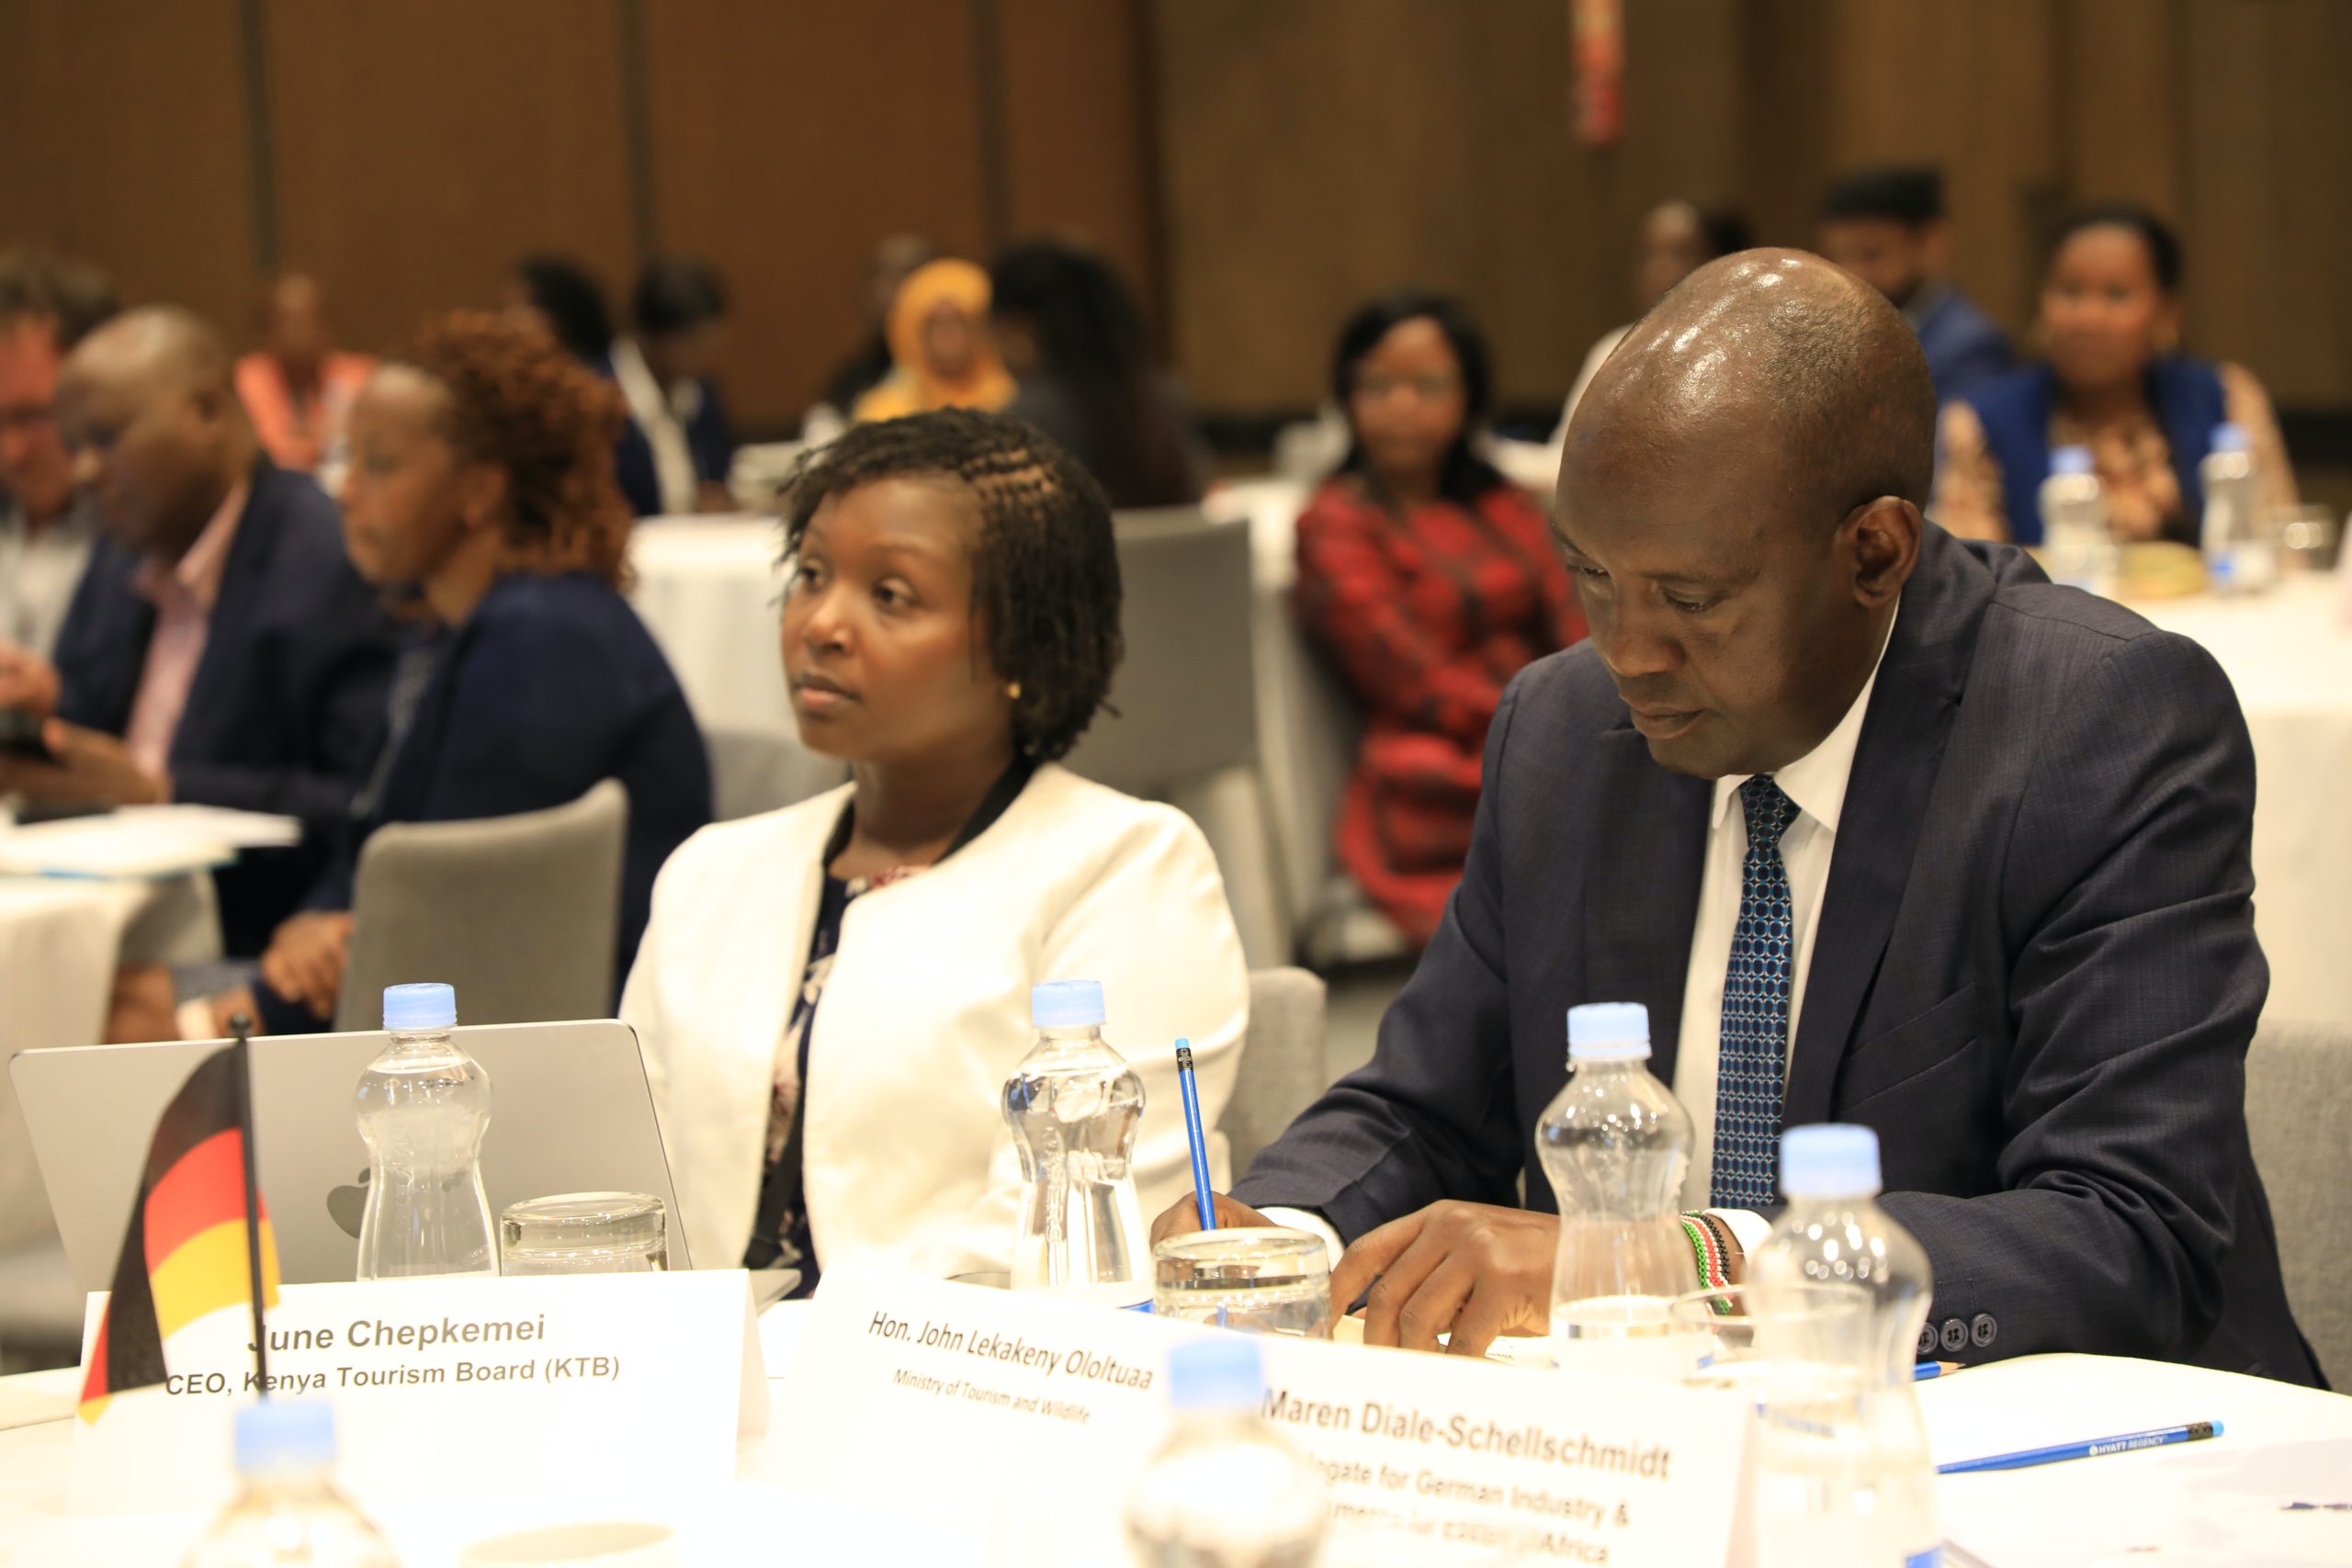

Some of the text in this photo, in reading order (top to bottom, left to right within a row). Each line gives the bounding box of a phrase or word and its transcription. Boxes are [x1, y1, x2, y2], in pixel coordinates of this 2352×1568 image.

[347, 1314, 545, 1352] Chepkemei
[868, 1311, 1153, 1390] Hon. John Lekakeny Ololtuaa
[165, 1356, 620, 1396] CEO, Kenya Tourism Board (KTB)
[893, 1369, 1091, 1424] Ministry of Tourism and Wildlife
[1261, 1387, 1670, 1482] Maren Diale-Schellschmidt
[2098, 1441, 2127, 1455] HYATT
[1378, 1465, 1410, 1490] for
[1416, 1469, 1505, 1506] German
[1510, 1484, 1606, 1529] Industry
[1612, 1500, 1630, 1528] &
